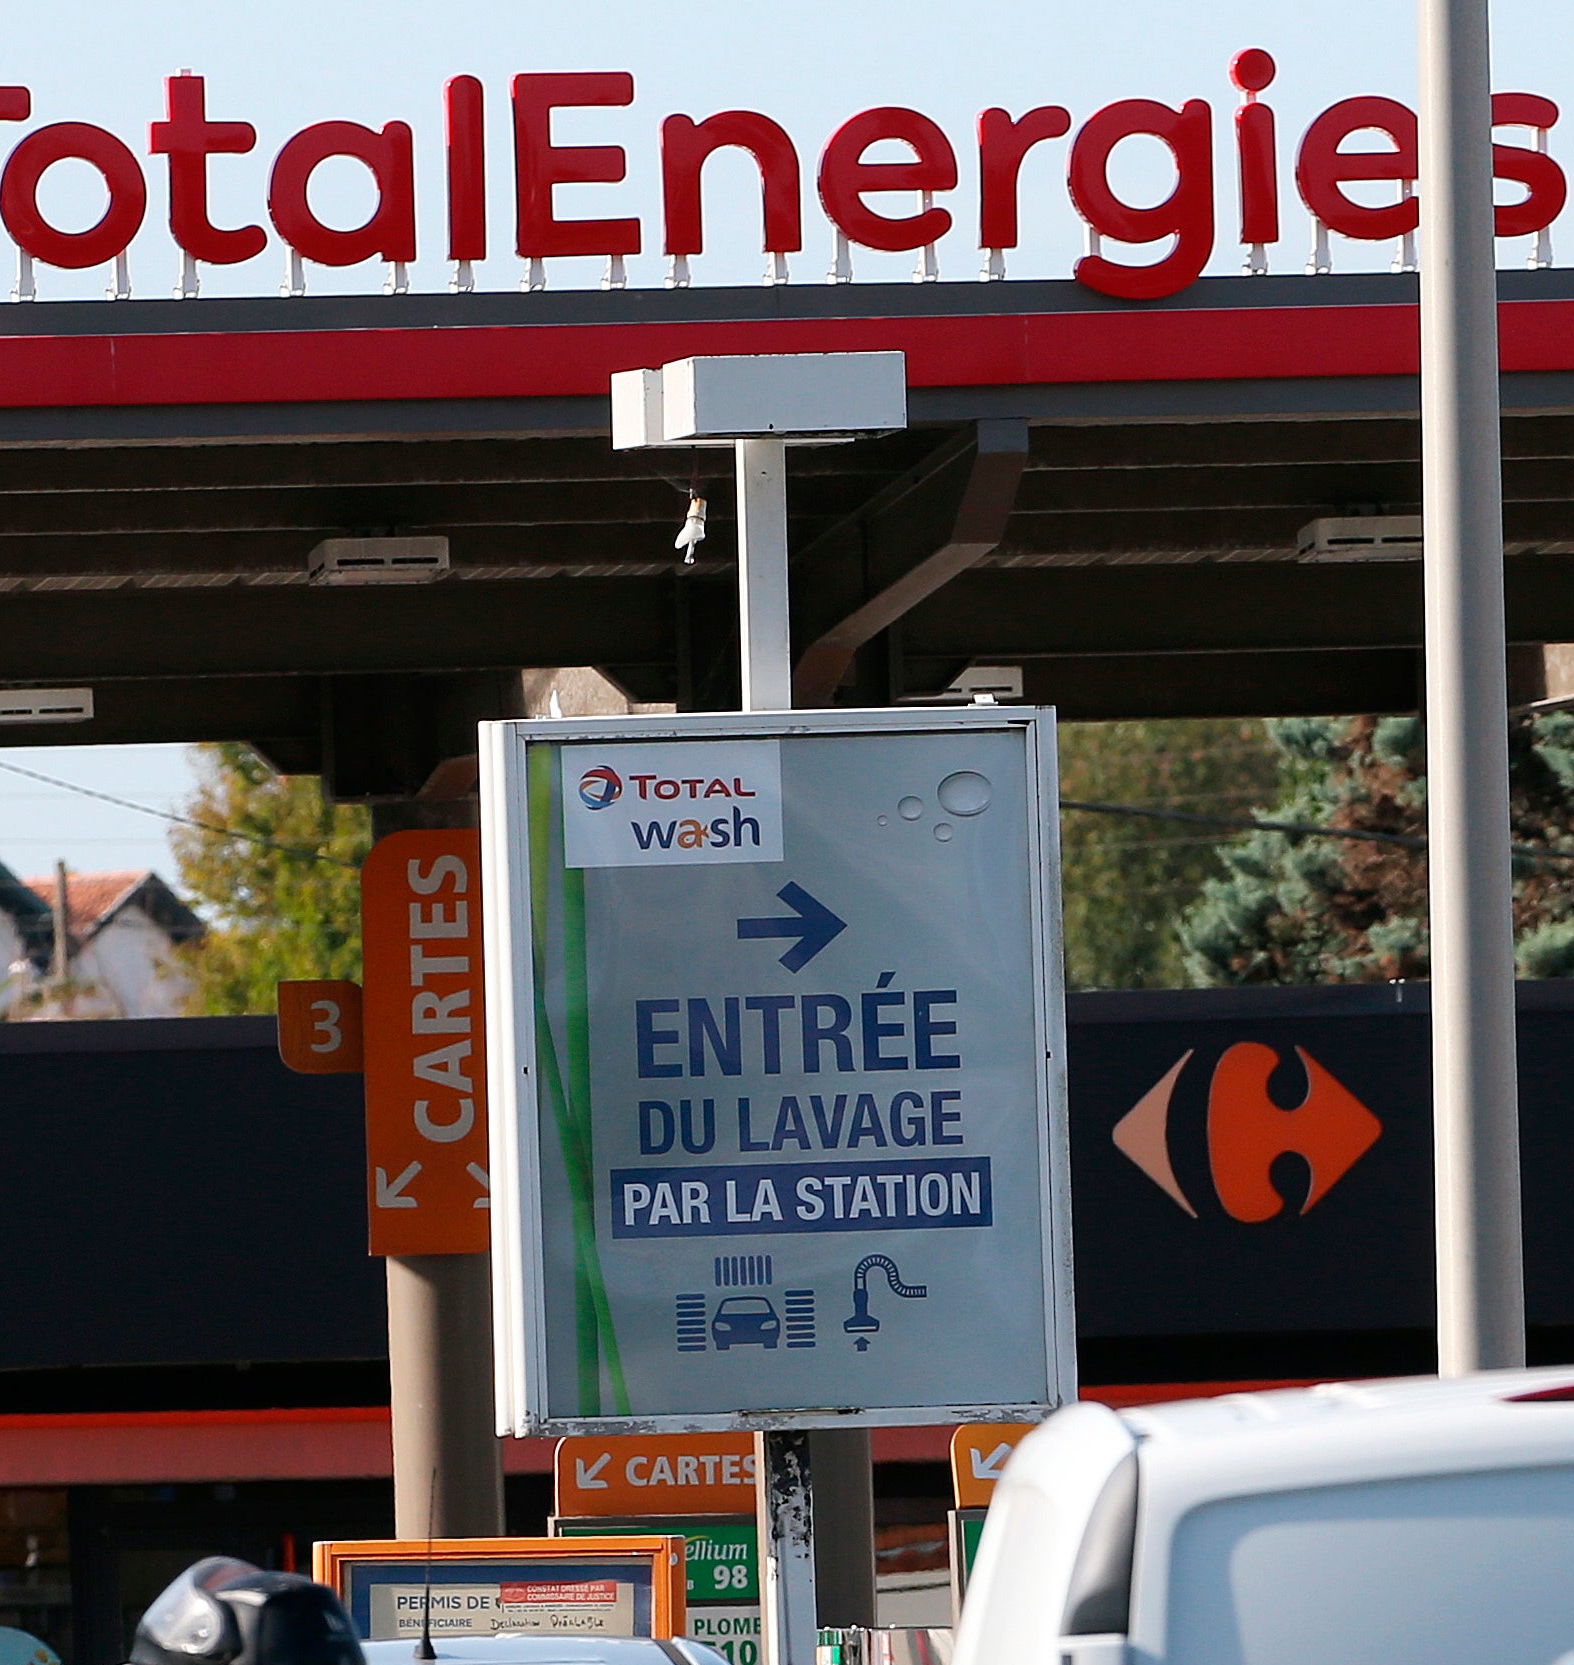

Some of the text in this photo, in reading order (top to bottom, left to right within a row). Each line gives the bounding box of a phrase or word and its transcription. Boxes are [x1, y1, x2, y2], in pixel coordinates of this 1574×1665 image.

[629, 774, 756, 801] TOTAL
[631, 806, 761, 851] wash
[407, 853, 473, 1144] CARTES
[310, 1000, 342, 1052] 3
[636, 972, 962, 1079] ENTRÉE
[638, 1090, 964, 1157] DU LAVAGE
[624, 1171, 982, 1228] PAR LA STATION
[685, 1539, 748, 1561] ellium
[713, 1564, 748, 1590] 98
[397, 1596, 462, 1610] PERMIS
[467, 1596, 490, 1610] DE
[399, 1616, 473, 1628] BÉNFICIAIRE
